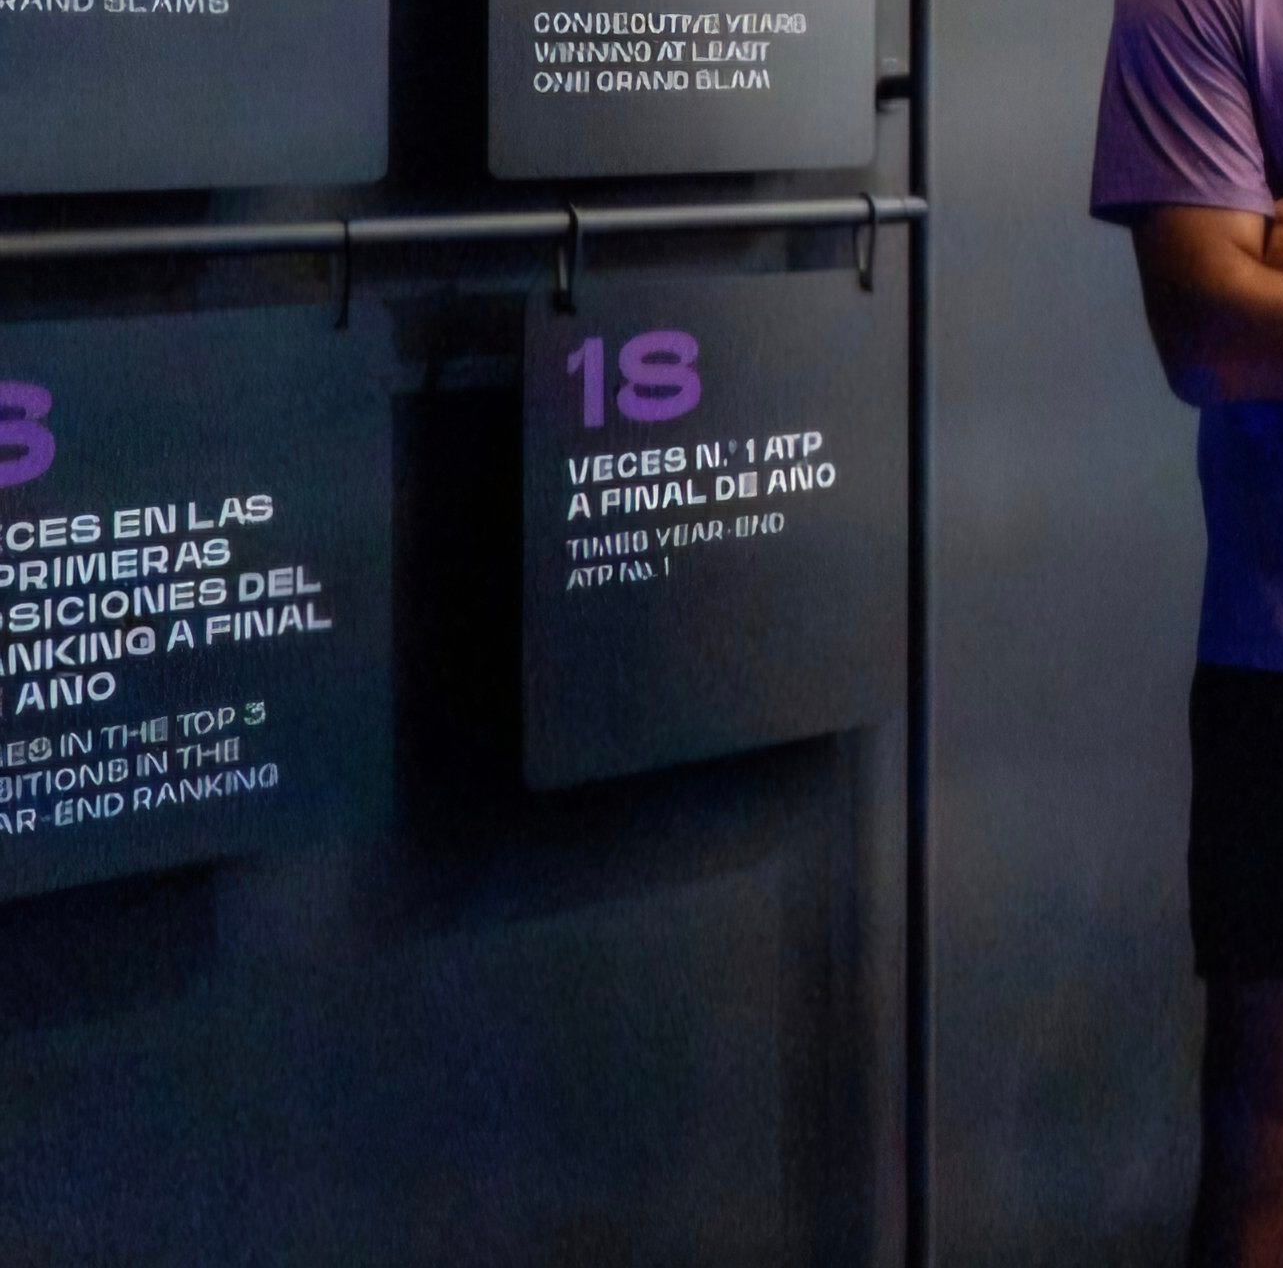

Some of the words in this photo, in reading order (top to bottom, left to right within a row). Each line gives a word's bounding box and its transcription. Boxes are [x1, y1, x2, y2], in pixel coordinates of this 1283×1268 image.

[596, 69, 689, 93] GRAND
[695, 69, 770, 90] SLAM
[567, 330, 700, 427] 18
[569, 446, 687, 485] VECES
[746, 438, 755, 463] 1
[764, 431, 822, 462] ATP
[0, 515, 101, 551] CES
[114, 503, 176, 539] EN
[189, 494, 273, 530] LAS
[567, 492, 591, 521] A
[601, 479, 707, 516] FINAL
[0, 578, 227, 632] SICIONES
[238, 566, 321, 602] DEL
[0, 626, 156, 676] NKING
[167, 619, 194, 652] A
[206, 602, 332, 645] FINAL
[60, 729, 92, 757] IN
[101, 716, 168, 749] THE
[177, 707, 235, 737] TOP
[136, 750, 168, 777] IN
[177, 736, 240, 770] THE
[133, 763, 278, 811] RANKING
